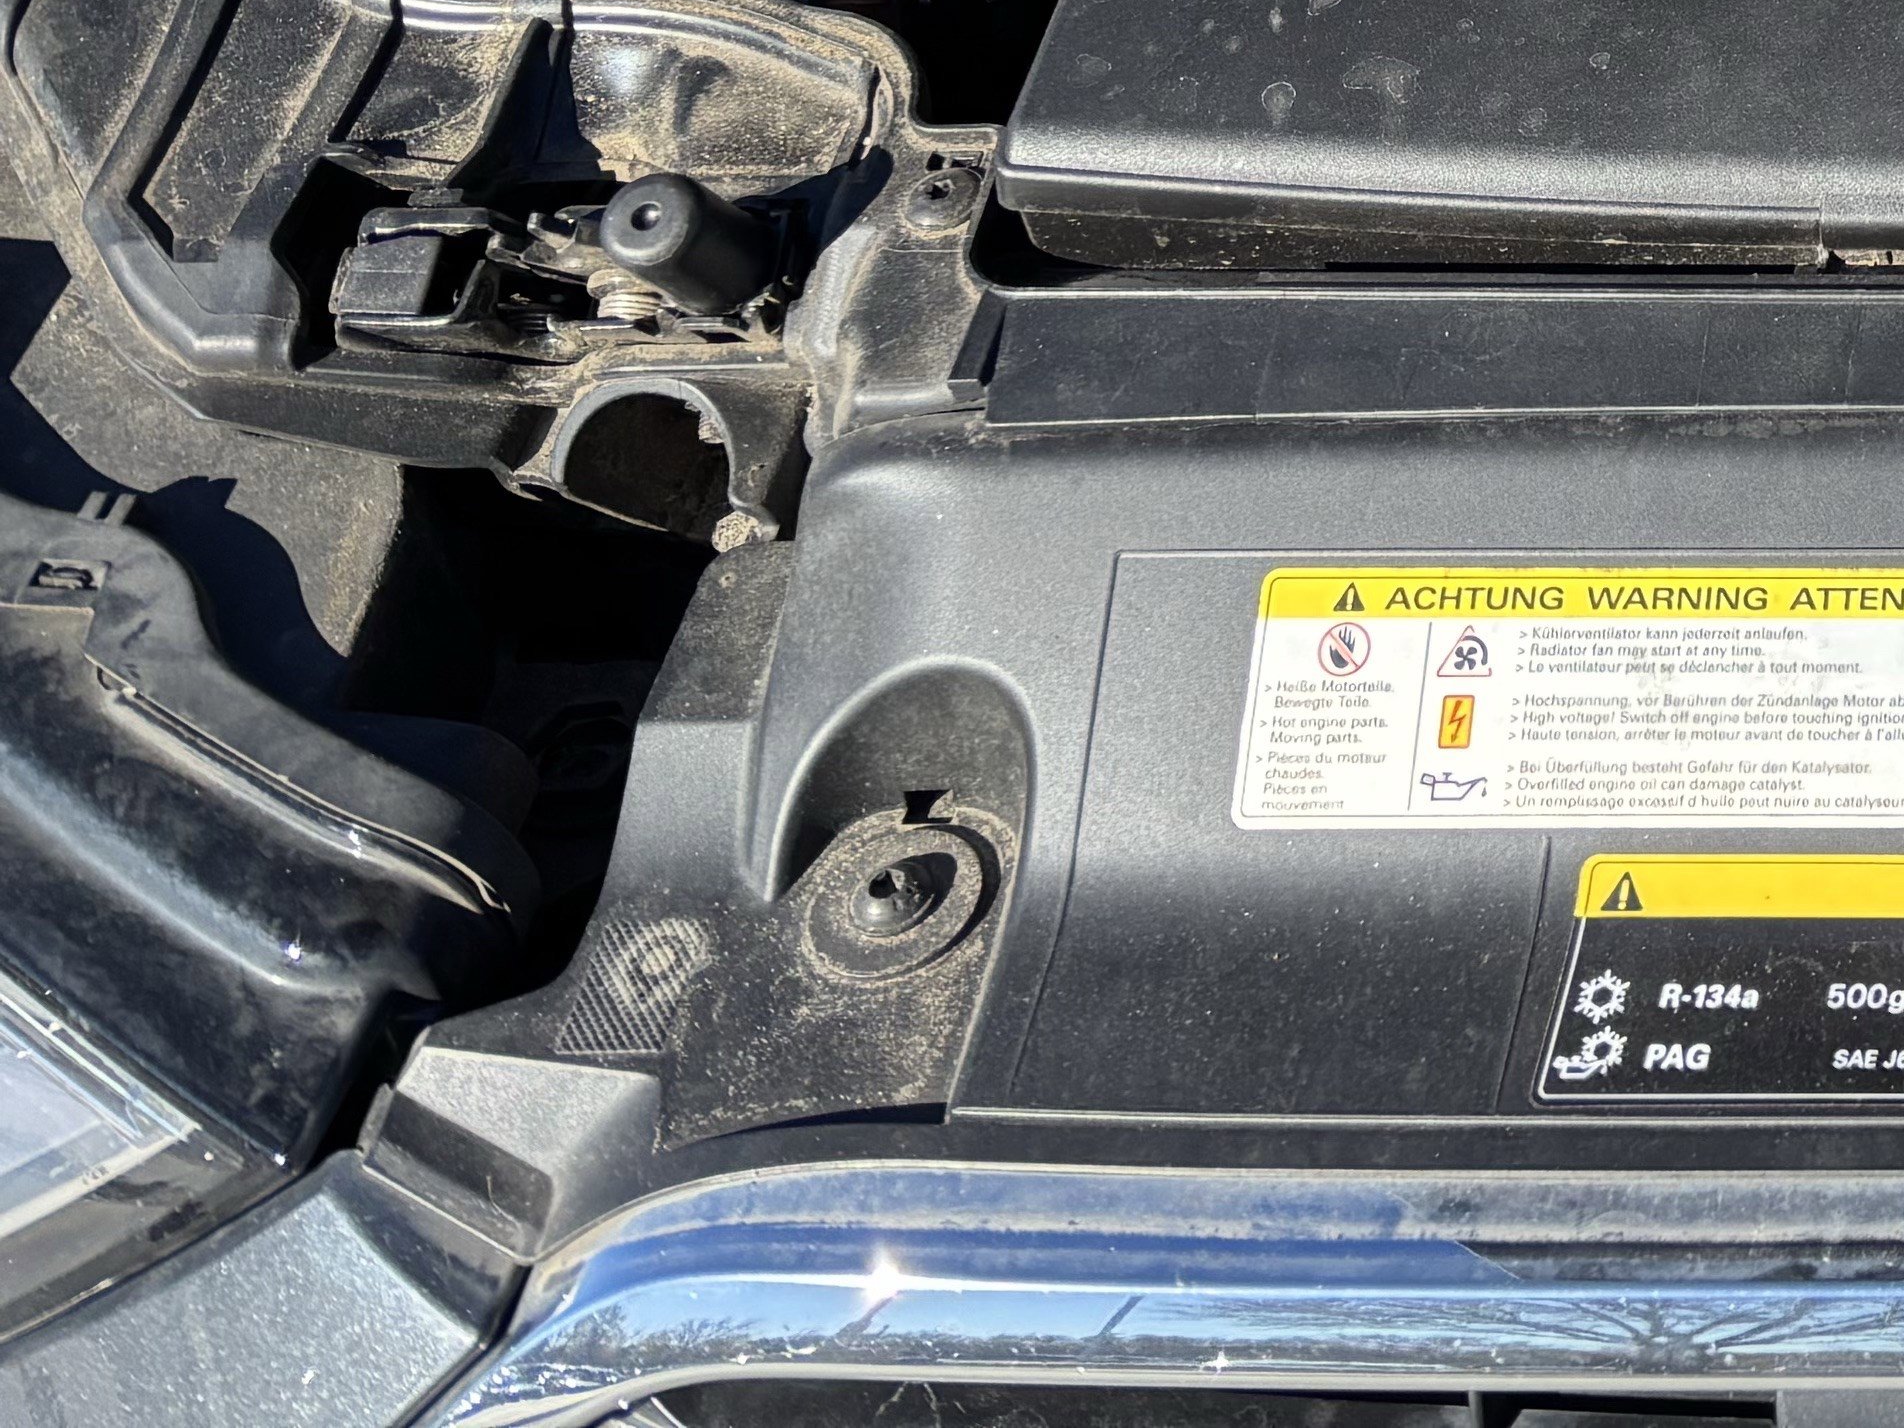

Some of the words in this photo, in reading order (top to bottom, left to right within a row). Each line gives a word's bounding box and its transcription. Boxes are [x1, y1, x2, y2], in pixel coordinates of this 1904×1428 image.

[1385, 587, 1564, 610] ACHTUNG
[1588, 587, 1767, 610] WARNING
[1646, 628, 1678, 639] kann
[1531, 643, 1587, 656] Radiator
[1593, 643, 1613, 656] fan
[1618, 647, 1647, 660] may
[1651, 646, 1681, 656] start
[1686, 646, 1698, 656] at
[1703, 647, 1727, 658] any
[1732, 646, 1765, 656] time.
[1529, 660, 1544, 673] Le
[1549, 660, 1623, 673] ventilateur
[1758, 661, 1765, 673] à
[1770, 662, 1797, 674] tout
[1802, 663, 1862, 673] moment.
[1663, 694, 1726, 707] Berühren
[1731, 694, 1753, 707] der
[1844, 695, 1884, 707] Motor
[1301, 719, 1346, 730] engine
[1523, 711, 1554, 726] High
[1620, 710, 1666, 724] Switch
[1671, 711, 1689, 723] off
[1693, 714, 1739, 727] engine
[1744, 711, 1787, 724] before
[1793, 712, 1852, 726] touching
[1270, 731, 1321, 746] Moving
[1522, 728, 1561, 740] Haute
[1691, 730, 1740, 741] moteur
[1745, 730, 1782, 741] avant
[1787, 729, 1803, 740] de
[1808, 728, 1860, 741] toucher
[1865, 729, 1872, 741] à
[1633, 761, 1682, 773] besteht
[1688, 760, 1733, 773] Gefahr
[1739, 761, 1757, 773] für
[1761, 761, 1787, 774] den
[1518, 778, 1585, 790] Overfilled
[1640, 778, 1657, 790] oil
[1661, 781, 1684, 790] can
[1689, 778, 1745, 793] damage
[1516, 795, 1535, 807] Un
[1740, 797, 1769, 809] peut
[1774, 798, 1809, 808] nuire
[1814, 798, 1830, 807] au
[1659, 983, 1759, 1012] R-134a
[1643, 1043, 1711, 1070] PAG
[1833, 1049, 1878, 1069] SAE
